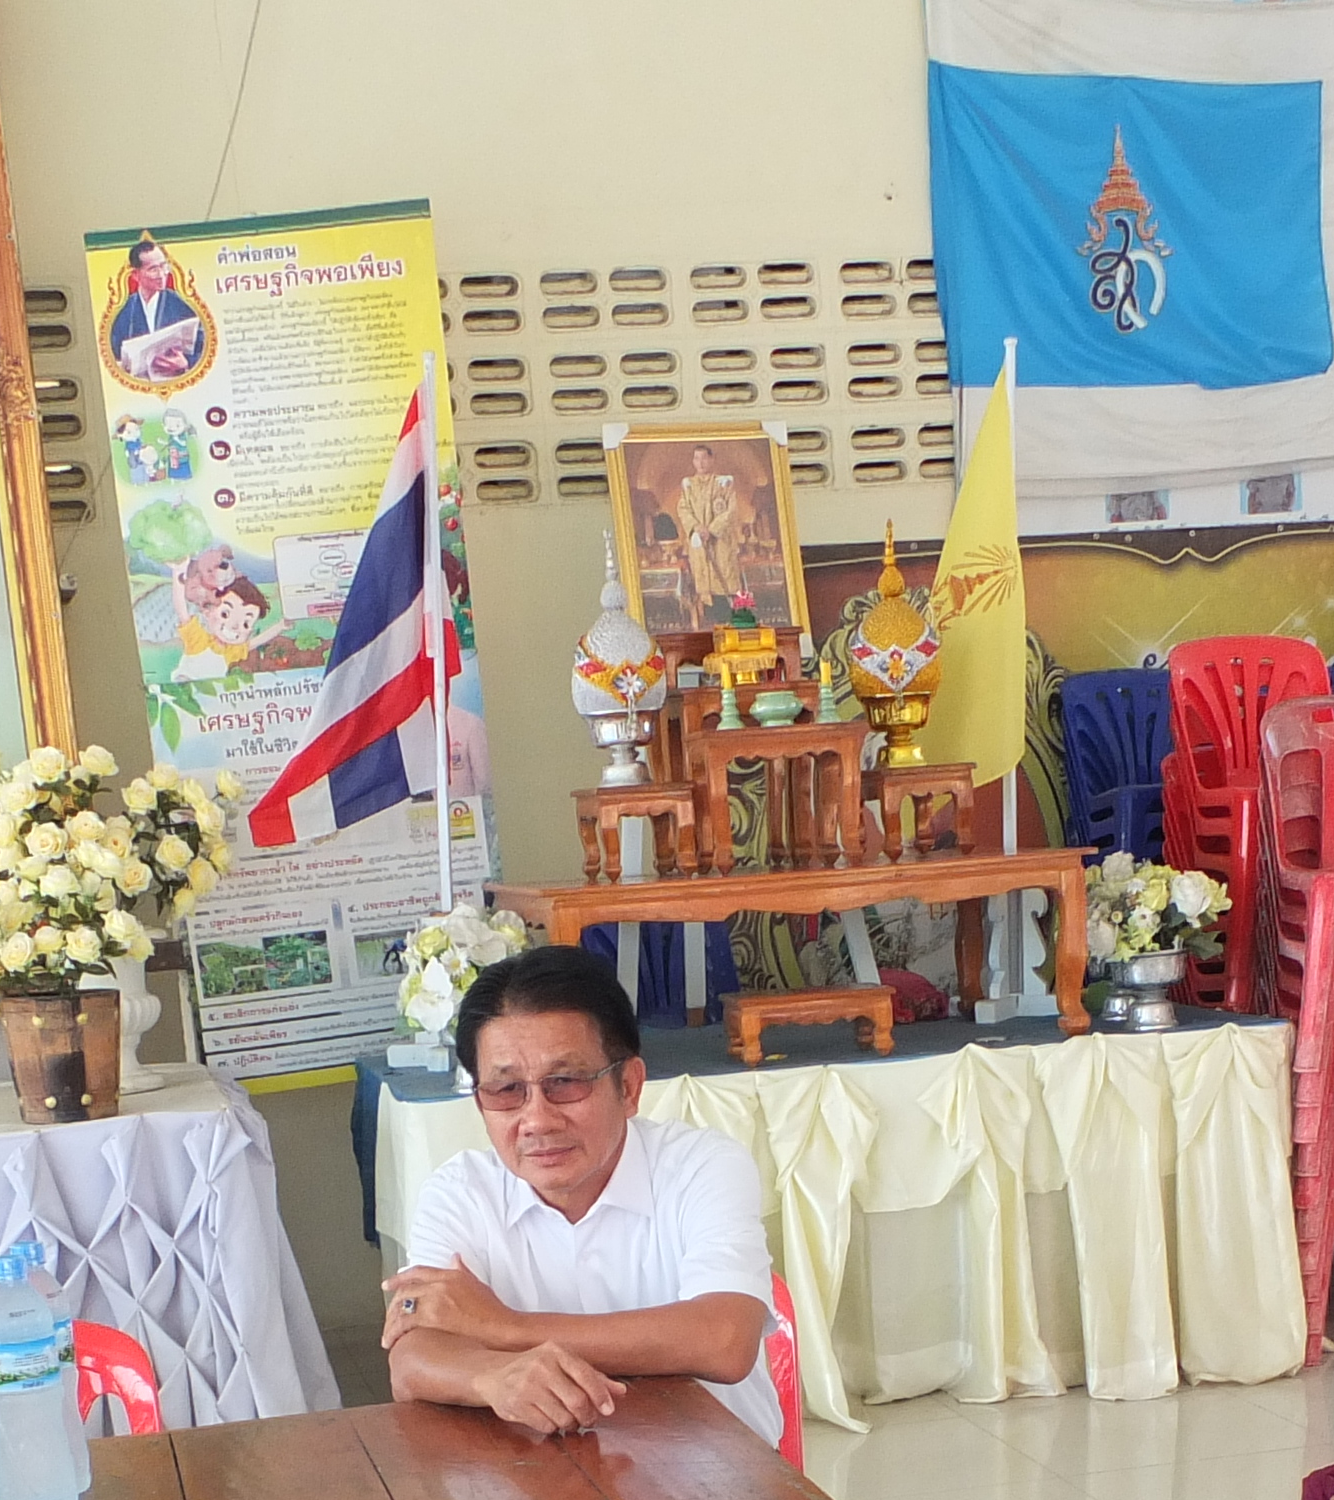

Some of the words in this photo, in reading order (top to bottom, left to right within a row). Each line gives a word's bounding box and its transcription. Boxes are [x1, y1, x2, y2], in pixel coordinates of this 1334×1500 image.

[217, 244, 297, 265] คำพ่อสอน
[216, 253, 404, 298] เศรษฐกิจพอเพียง
[220, 679, 324, 704] การนำหลักปรัช
[199, 702, 312, 735] เศรษฐกิจพ
